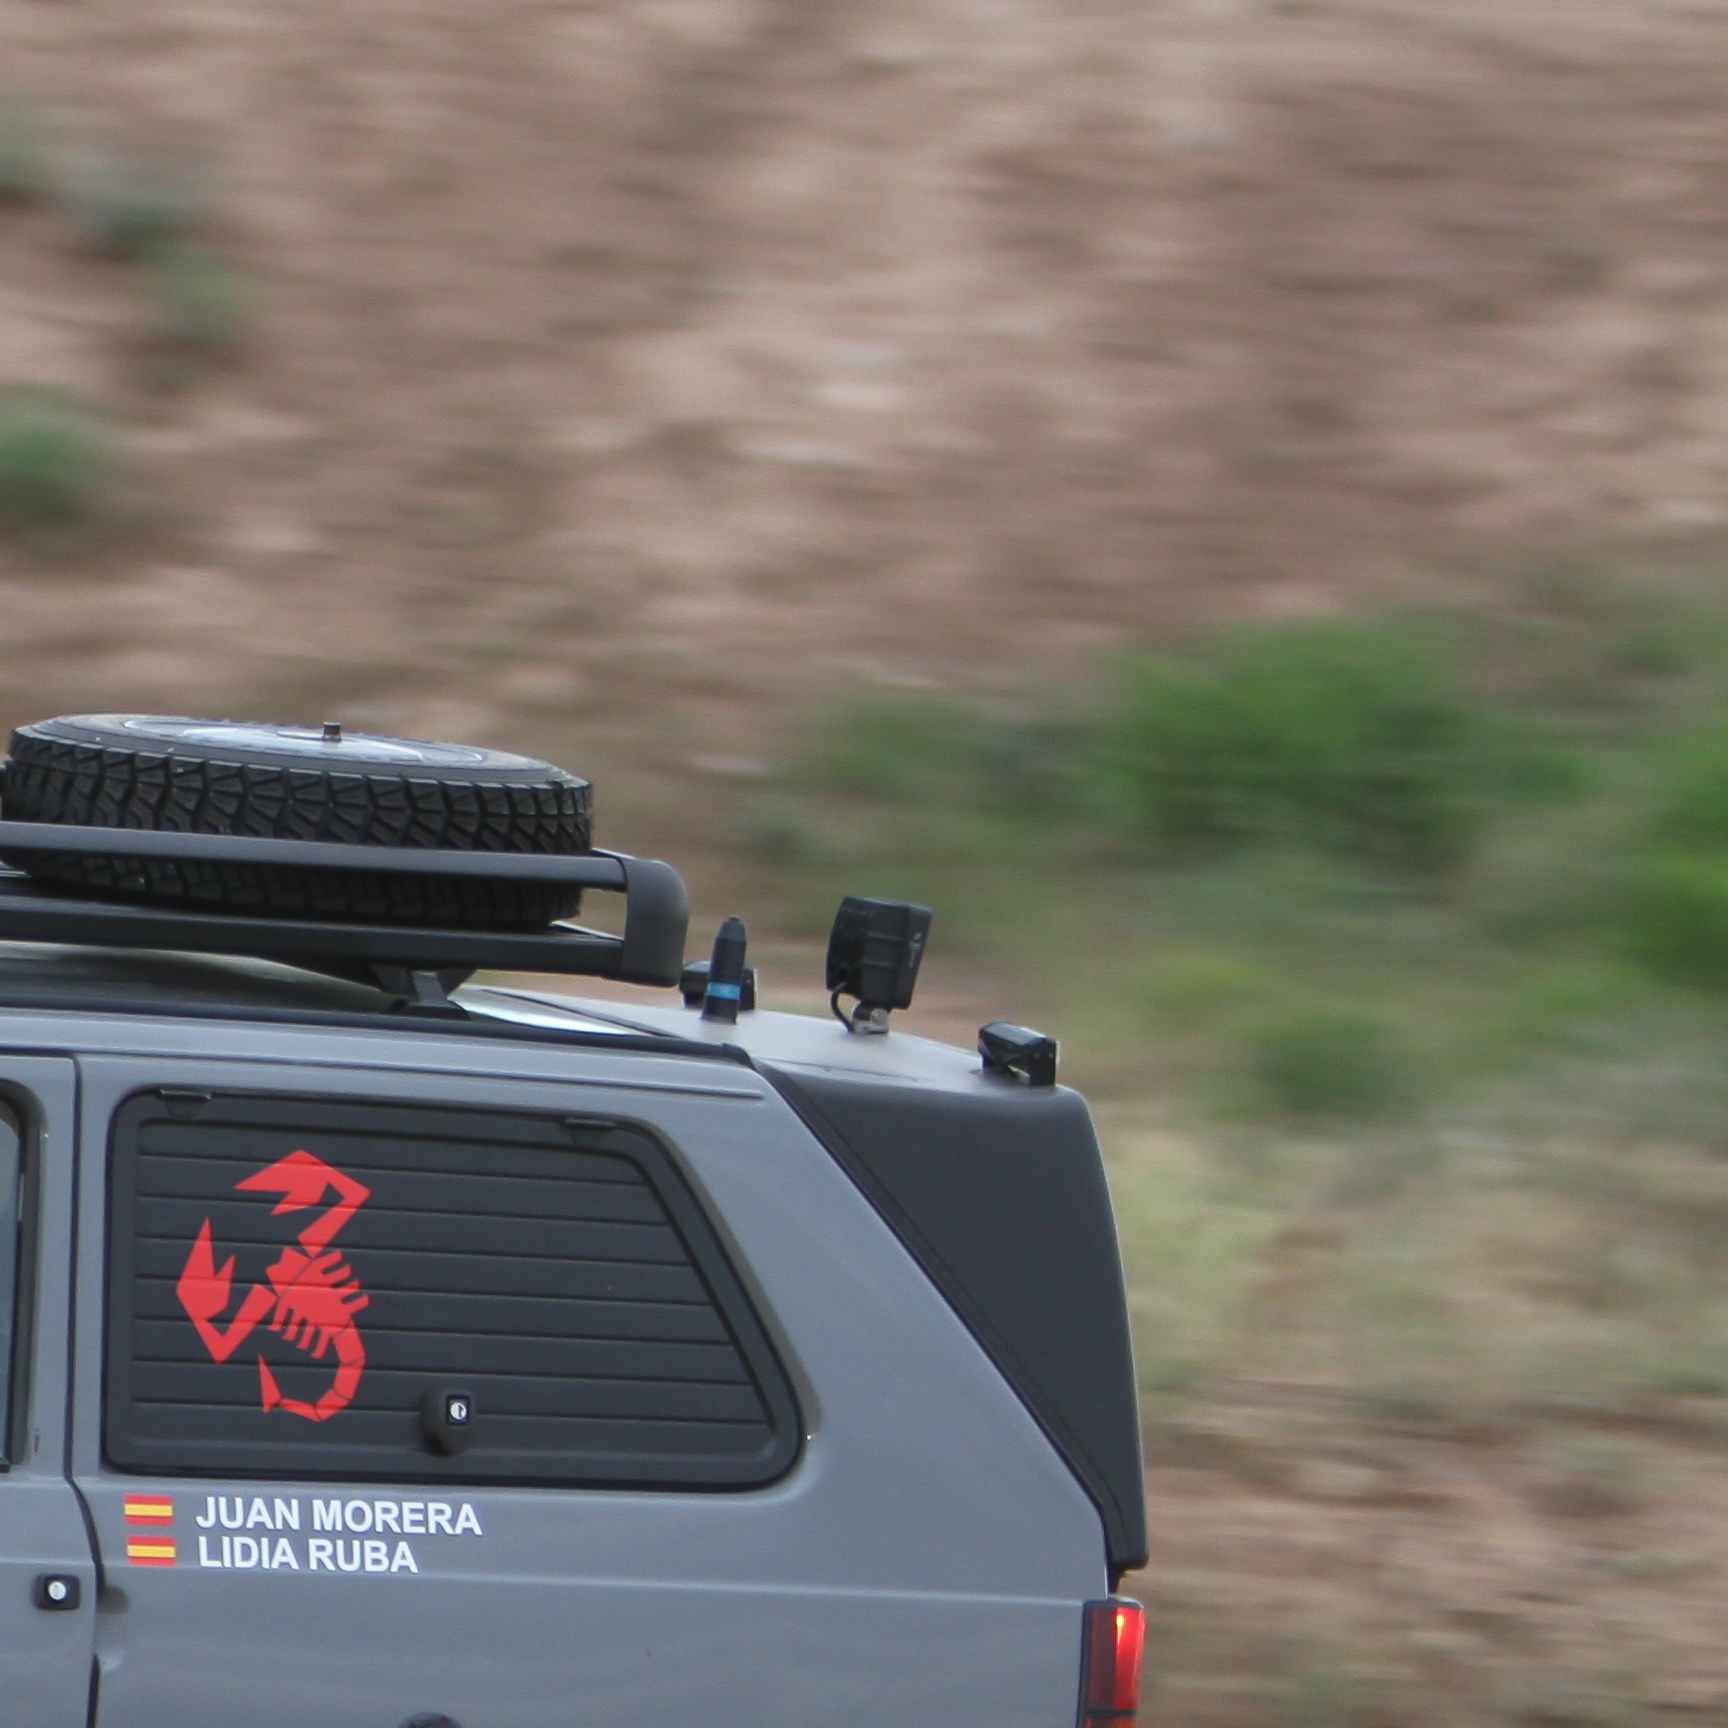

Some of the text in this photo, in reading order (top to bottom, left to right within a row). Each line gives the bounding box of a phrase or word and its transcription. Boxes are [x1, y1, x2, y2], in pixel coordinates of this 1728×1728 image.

[196, 1496, 483, 1536] JUAN MORERA
[198, 1536, 419, 1574] LIDIA RUBA
